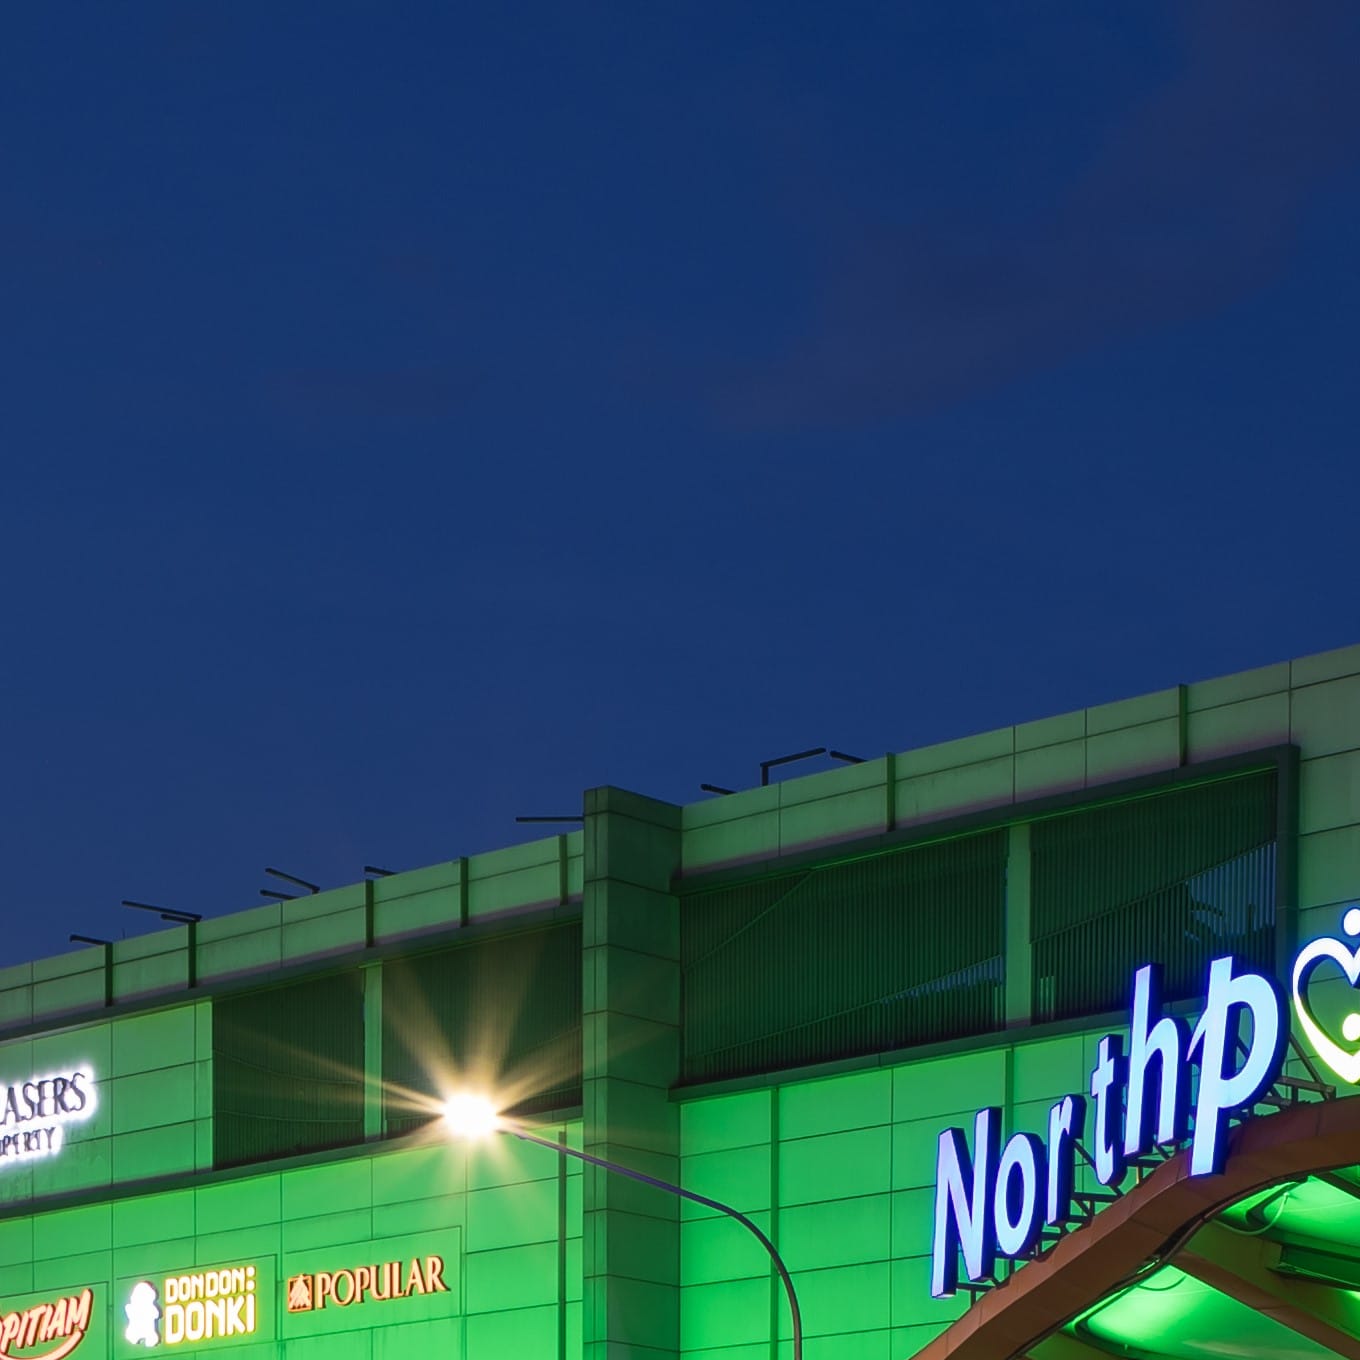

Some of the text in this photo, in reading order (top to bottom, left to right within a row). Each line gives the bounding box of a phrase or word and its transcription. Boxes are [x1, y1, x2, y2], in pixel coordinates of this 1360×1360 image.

[316, 1255, 451, 1309] POPULAR
[0, 1288, 93, 1354] PITIAM
[164, 1293, 257, 1345] DONKI
